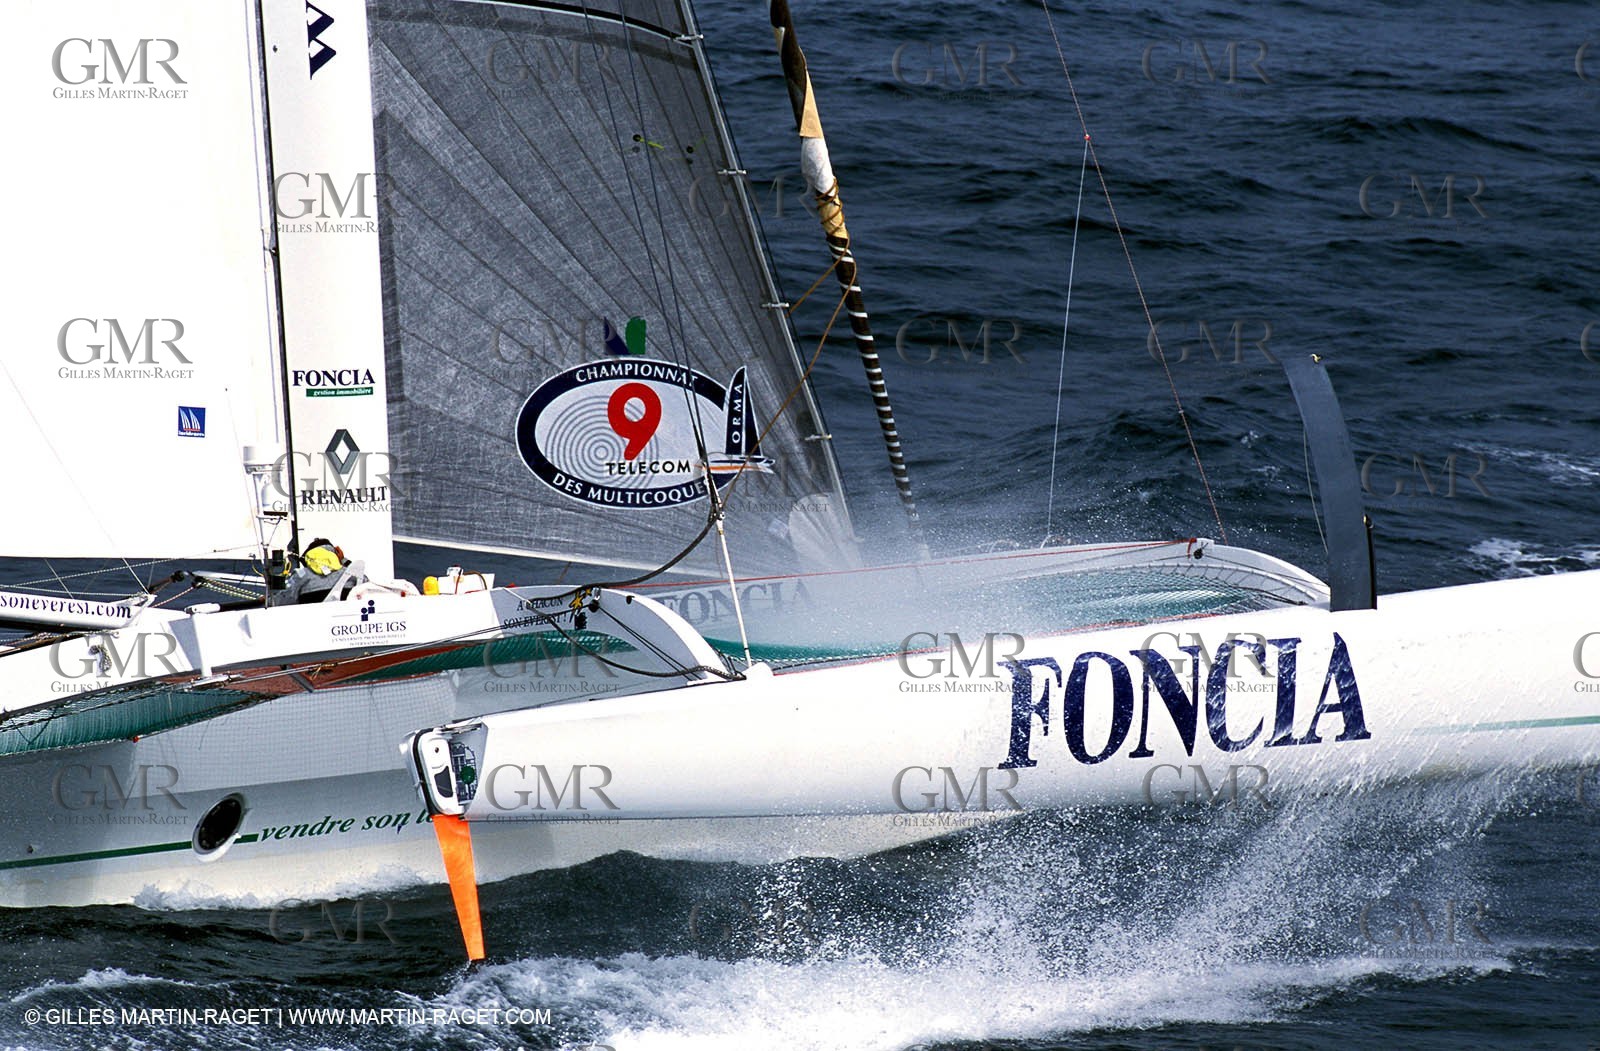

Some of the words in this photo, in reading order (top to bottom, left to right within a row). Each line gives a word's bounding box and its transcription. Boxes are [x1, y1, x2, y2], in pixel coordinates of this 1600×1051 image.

[292, 368, 376, 387] FONCIA
[575, 363, 698, 388] CHAMPIONNAT
[607, 382, 662, 461] 9
[731, 383, 743, 444] ORMA
[606, 459, 691, 475] TELECOM
[301, 486, 388, 505] RENAULT
[553, 473, 582, 495] DES
[587, 479, 709, 504] MULTICOQUE
[331, 622, 384, 637] GROUPE
[386, 620, 407, 633] IGS
[996, 632, 1372, 770] FONCIA
[261, 815, 356, 842] vendre
[361, 812, 411, 831] son
